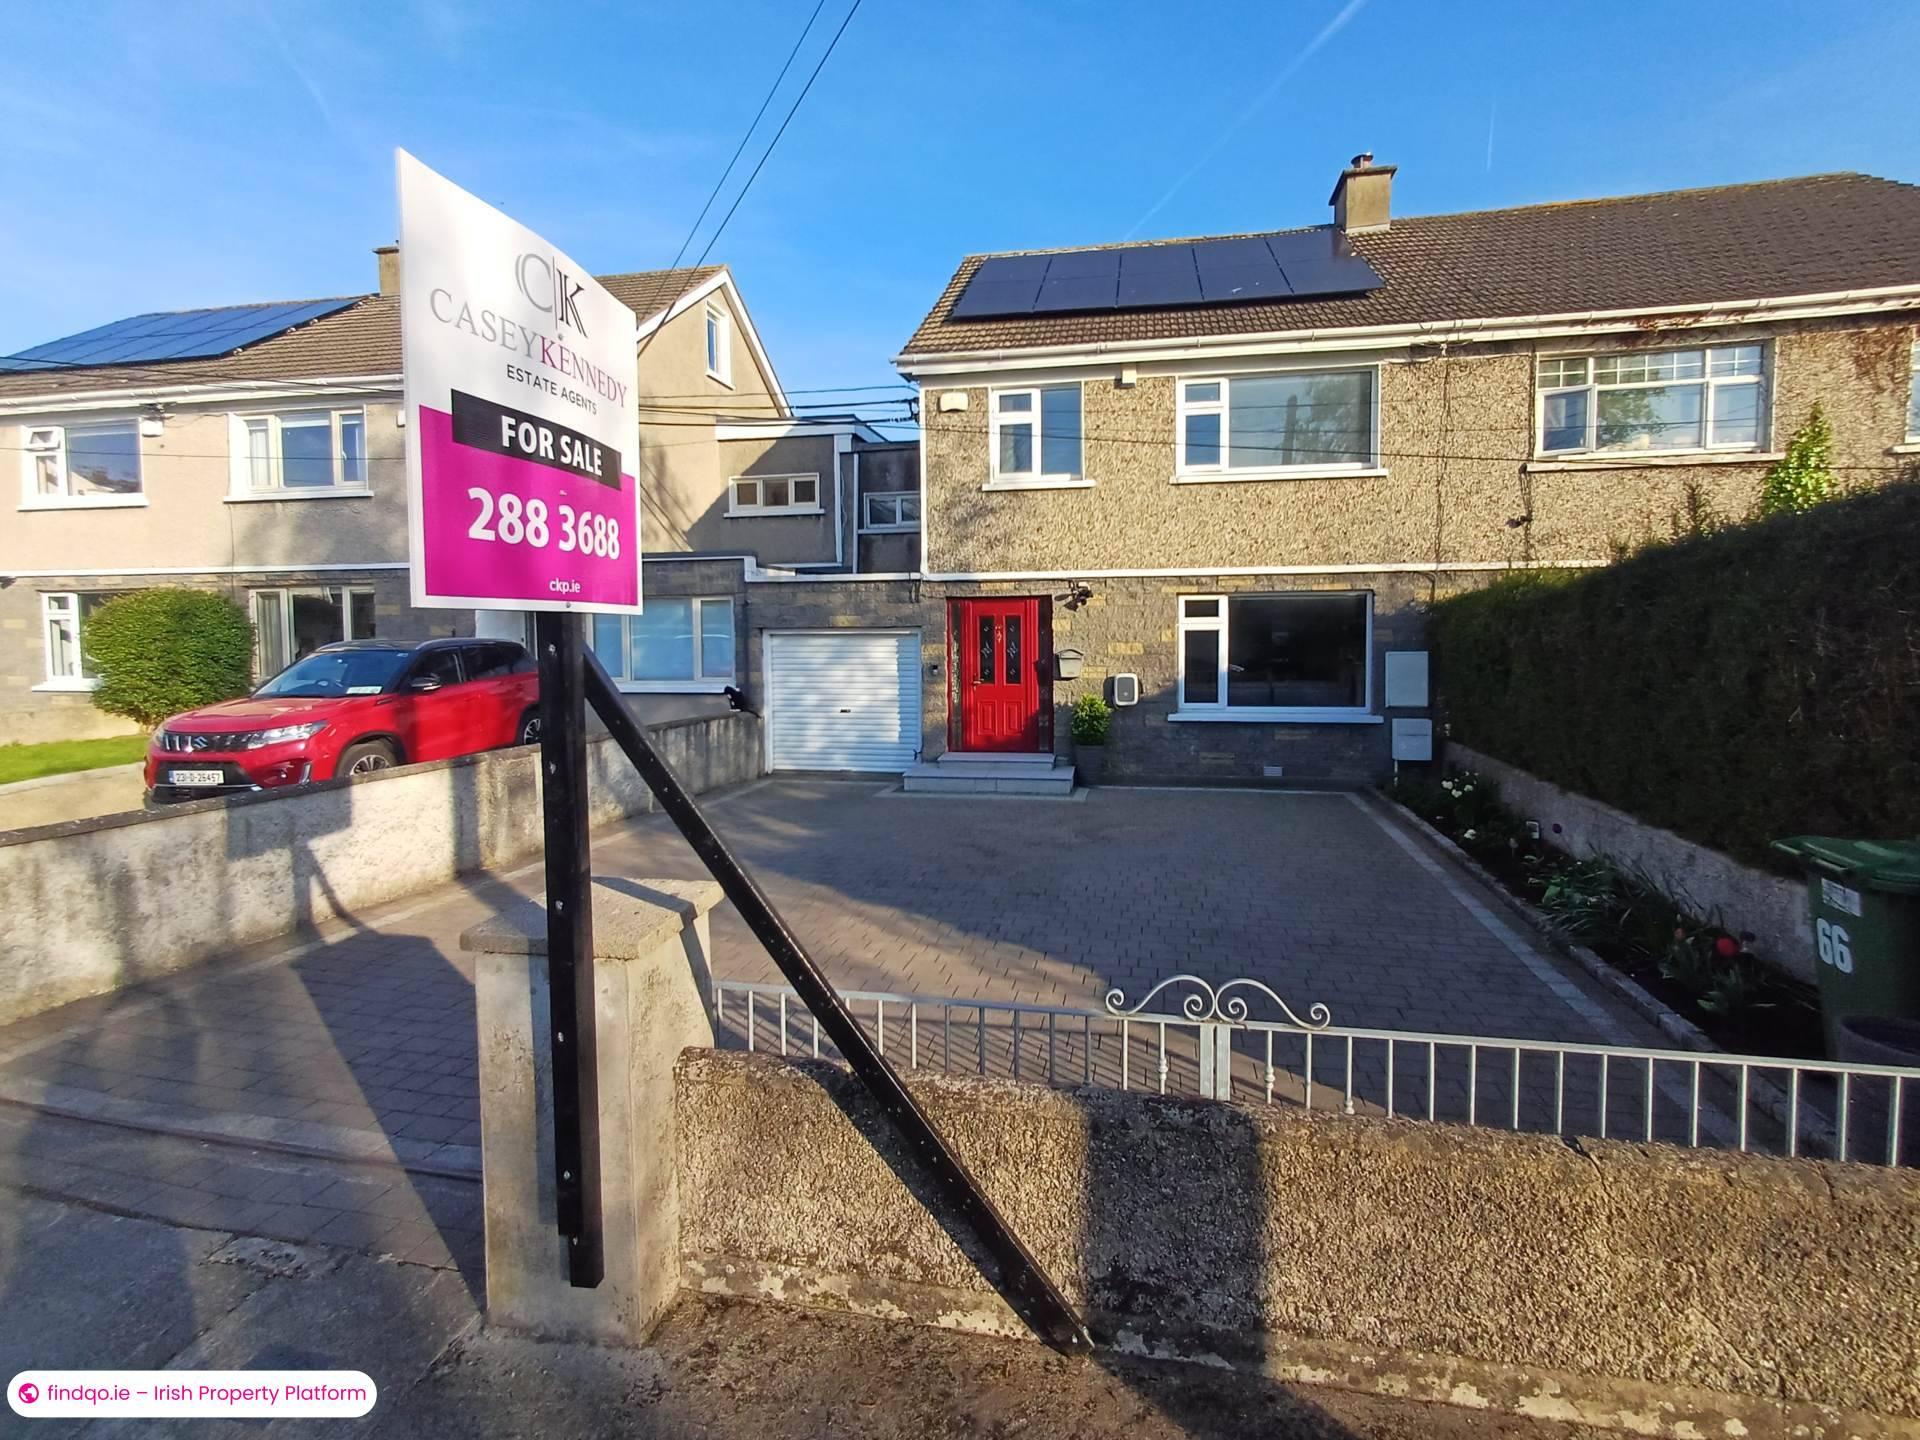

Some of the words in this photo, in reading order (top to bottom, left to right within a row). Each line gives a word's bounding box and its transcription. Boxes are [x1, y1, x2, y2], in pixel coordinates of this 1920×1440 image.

[430, 288, 628, 408] CASEYKENNEDY
[506, 364, 557, 396] ESTATE
[560, 388, 597, 415] AGENTS
[501, 415, 554, 460] FOR
[560, 434, 602, 477] SALE
[468, 487, 549, 549] 288
[559, 504, 620, 560] 3688
[549, 578, 581, 595] ckp.ie
[1816, 918, 1853, 974] 66
